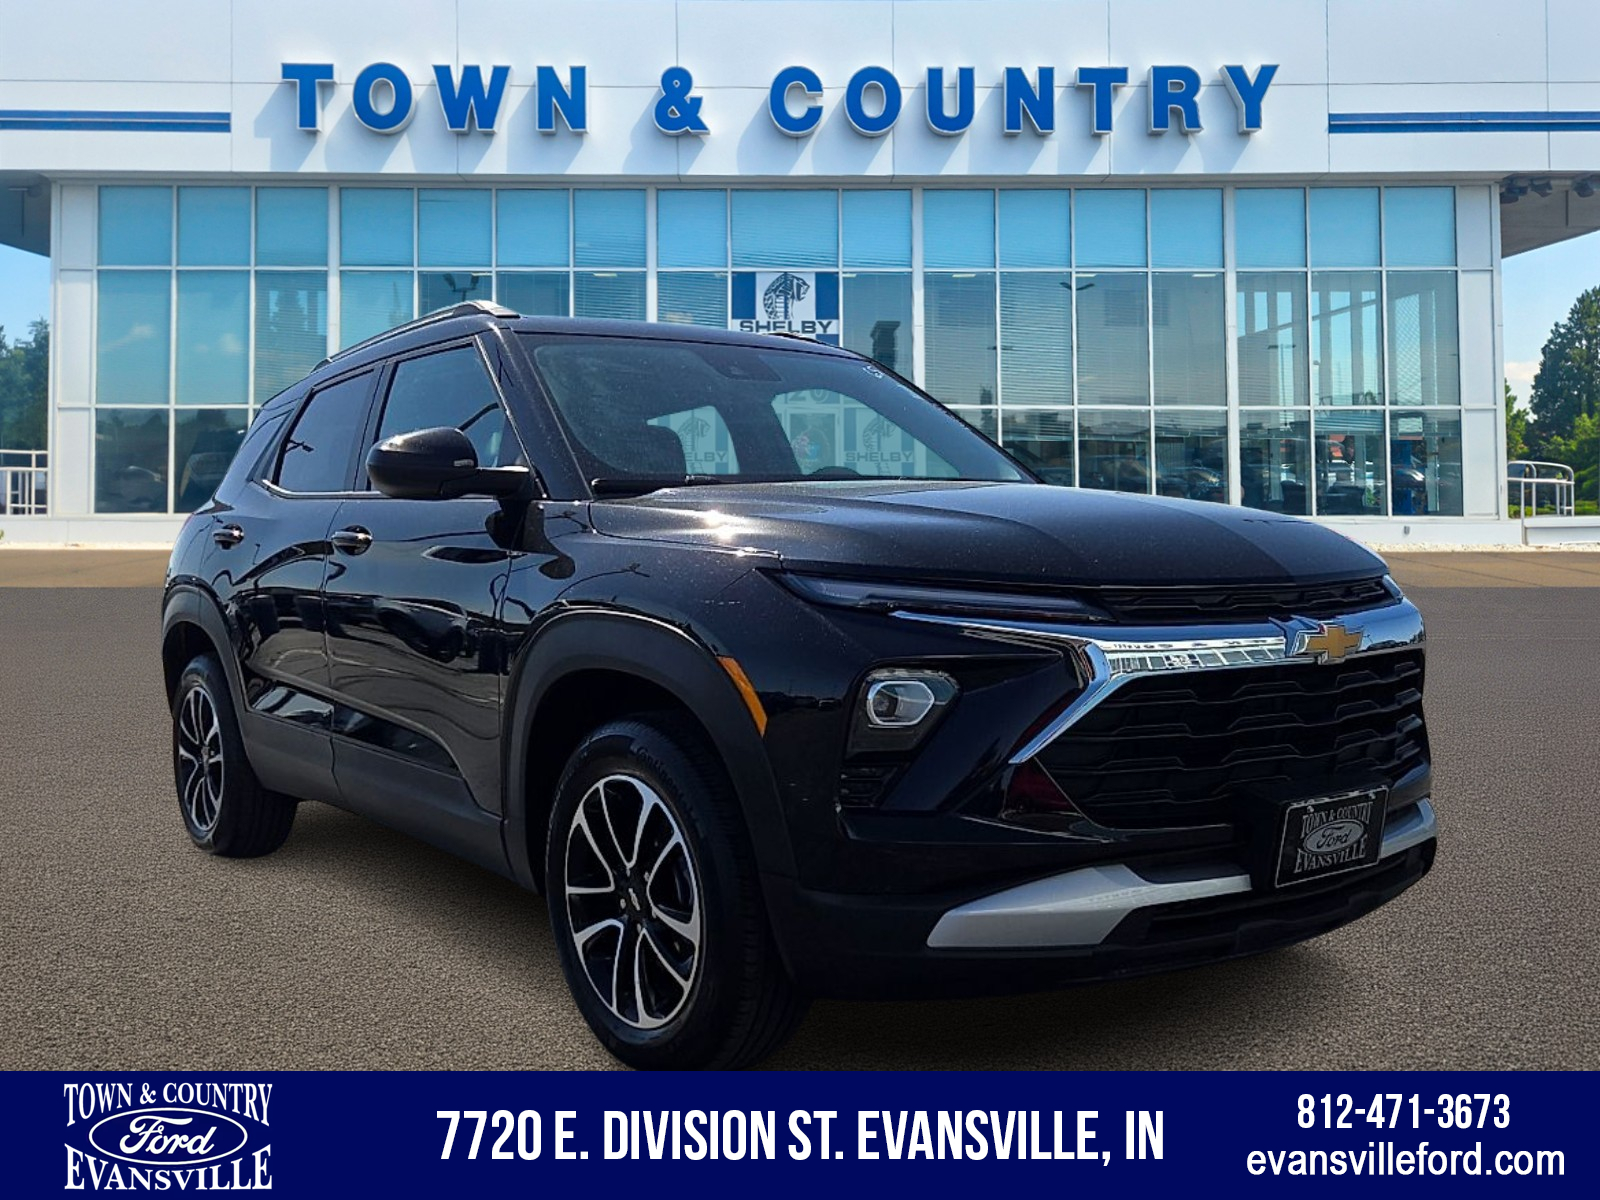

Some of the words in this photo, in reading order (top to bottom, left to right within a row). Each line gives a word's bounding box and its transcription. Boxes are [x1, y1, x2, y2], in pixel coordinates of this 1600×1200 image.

[281, 62, 589, 134] TOWN
[653, 66, 710, 136] &
[769, 64, 1280, 137] COUNTRY
[739, 320, 832, 334] SHELBY
[684, 452, 726, 462] ELBY
[845, 451, 913, 462] SHELBY
[1300, 811, 1328, 839] TOWN
[1336, 802, 1374, 825] COUNTRY
[1316, 823, 1352, 849] Ford
[1293, 834, 1369, 874] EVANSVILLE
